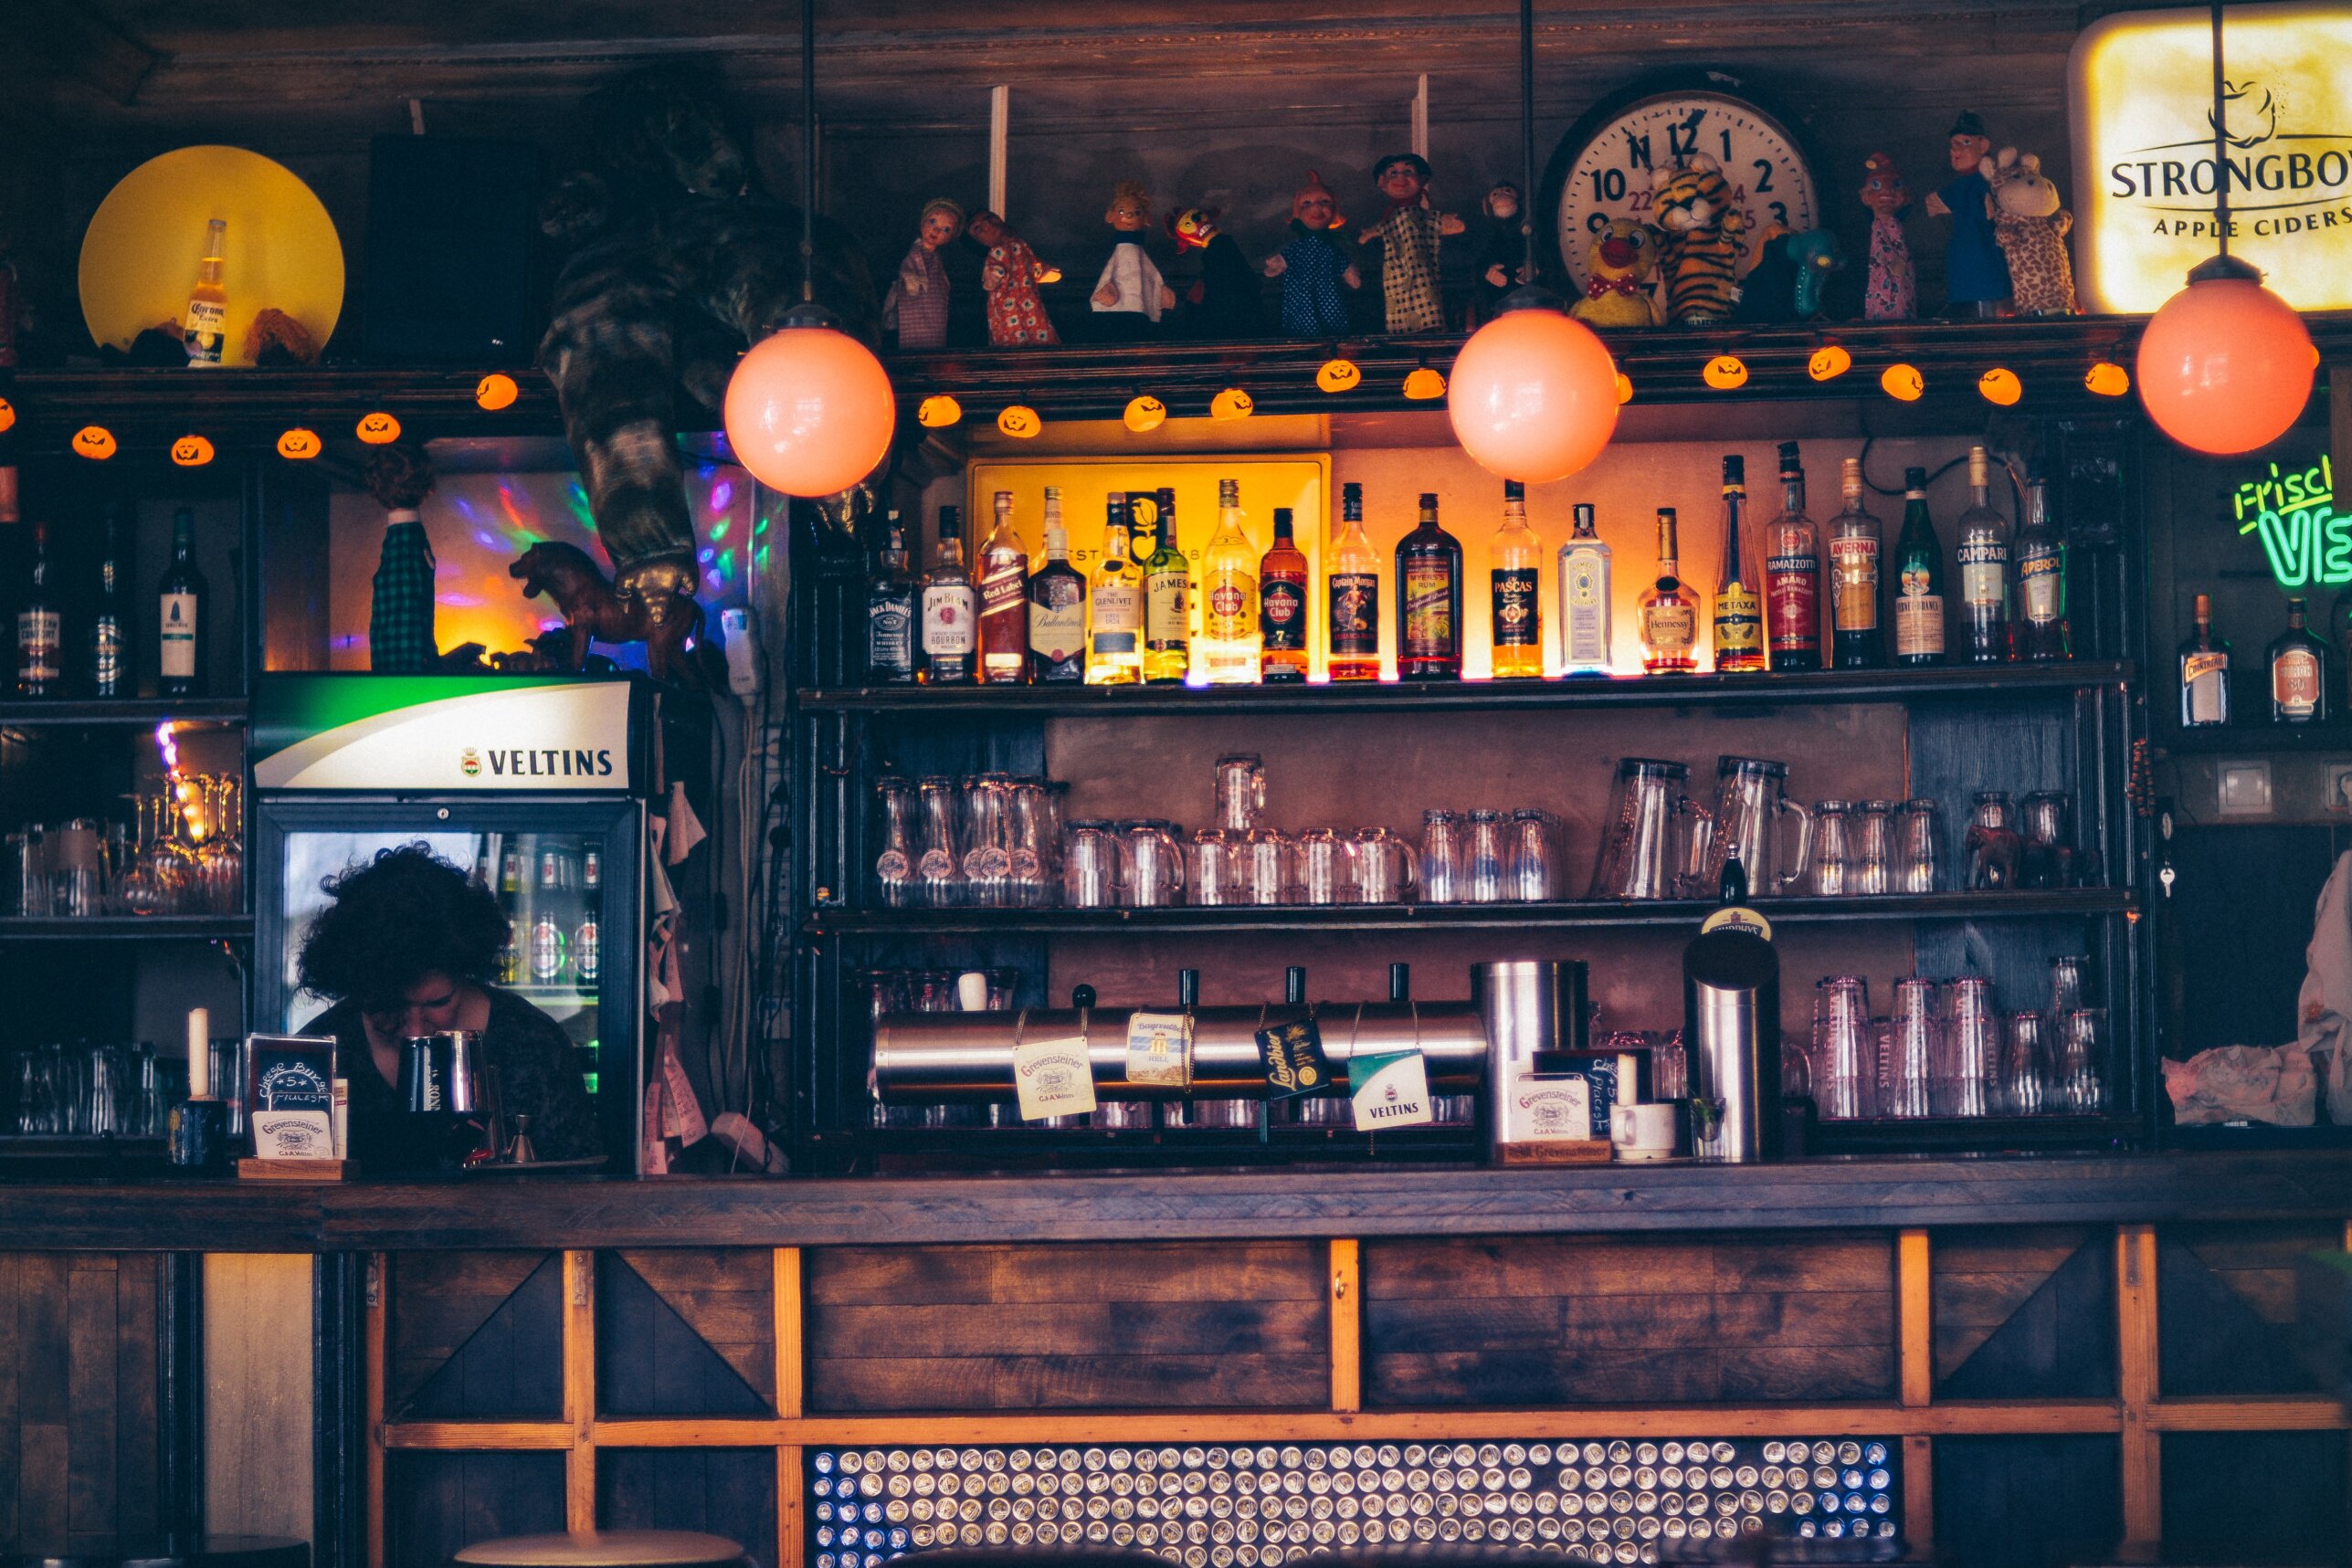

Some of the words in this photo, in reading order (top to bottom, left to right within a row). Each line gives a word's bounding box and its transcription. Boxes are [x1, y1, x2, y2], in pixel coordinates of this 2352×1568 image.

[1666, 121, 1699, 155] 12
[1719, 129, 1732, 163] 1
[1753, 158, 1774, 193] 2
[2111, 150, 2352, 198] STRONGBO
[1590, 168, 1627, 202] 10
[2254, 206, 2352, 237] CIDERS
[1832, 542, 1876, 556] AVERNA
[1957, 547, 2008, 562] CAMPARI
[1767, 559, 1816, 571] RAMAZZOTTI
[2020, 556, 2061, 577] APEROL
[1332, 576, 1354, 589] Captain
[1354, 575, 1376, 588] Morgan
[1494, 581, 1533, 593] PASCAS
[1777, 575, 1807, 587] AMARO
[983, 588, 999, 600] Red
[1001, 579, 1023, 593] Label
[1209, 591, 1247, 601] Havana
[927, 596, 943, 611] JIM
[1095, 597, 1133, 606] GLENLIVET
[1216, 601, 1238, 612] Club
[1263, 597, 1299, 607] Havana
[1717, 601, 1756, 610] METAXA
[1270, 607, 1291, 616] Club
[1034, 613, 1082, 627] Ballantine's
[1651, 620, 1689, 629] Hennessy
[931, 636, 965, 645] BOURBON
[1276, 630, 1285, 642] 7
[2188, 658, 2222, 677] COINTREAU
[488, 750, 613, 776] VELTINS
[1138, 1023, 1182, 1032] Bayreuthe
[1020, 1055, 1083, 1078] Grevensteiner
[1267, 1030, 1297, 1092] Landbier
[1879, 1034, 1891, 1089] VELTINS
[1987, 1031, 1999, 1088] VELTINS
[259, 1062, 286, 1098] Cheese
[1519, 1090, 1582, 1109] Grevensteiner
[1370, 1102, 1419, 1119] VELTINS
[261, 1120, 323, 1134] Grevensteiner
